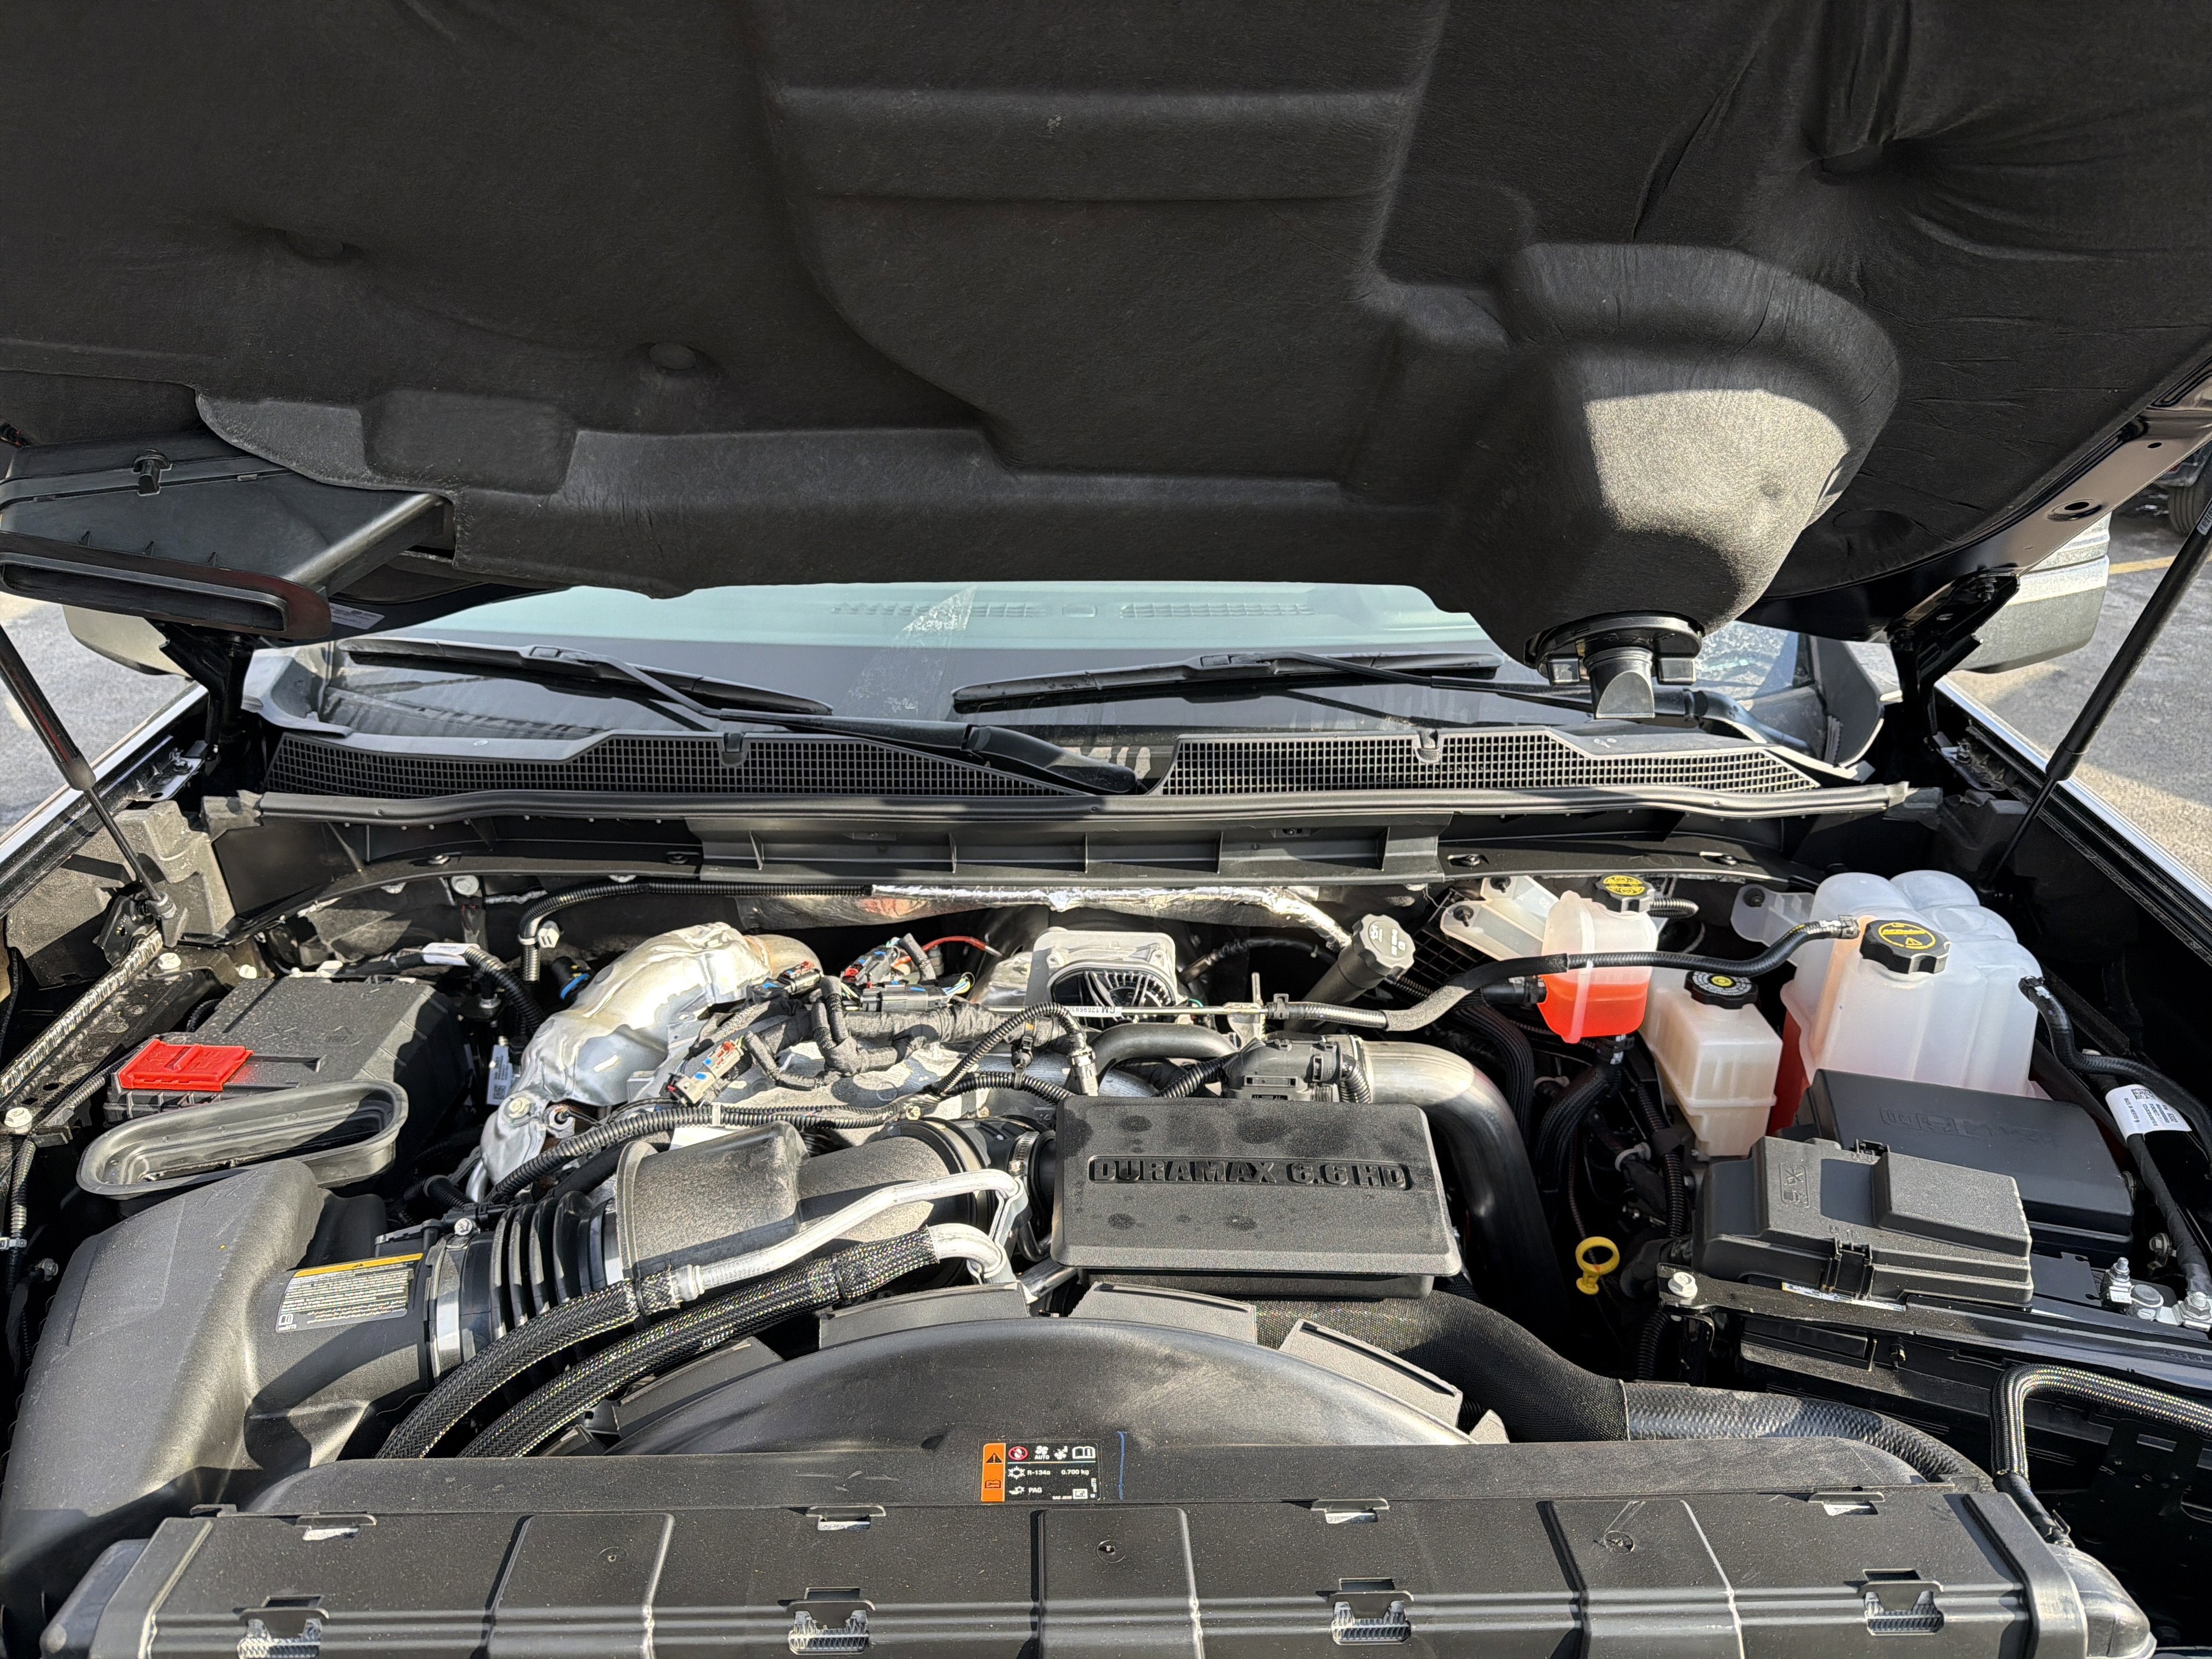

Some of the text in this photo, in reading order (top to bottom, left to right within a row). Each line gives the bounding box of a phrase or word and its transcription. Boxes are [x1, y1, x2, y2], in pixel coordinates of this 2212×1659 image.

[1094, 1159, 1406, 1189] DURAMAX 6.6 HD
